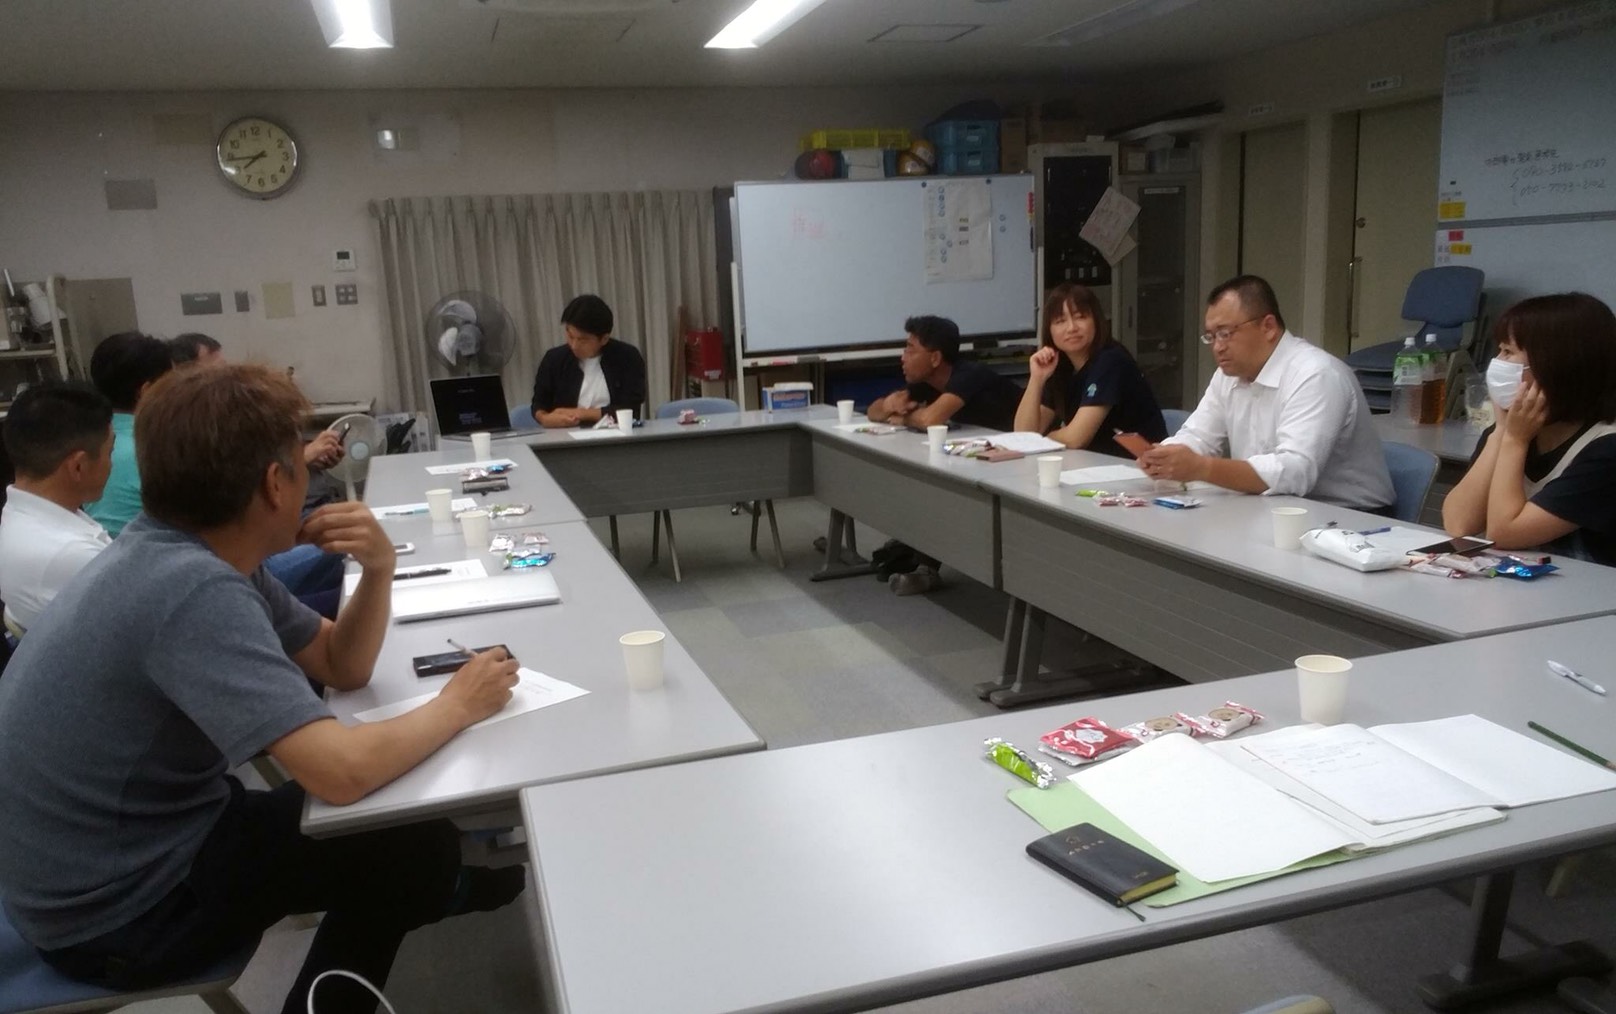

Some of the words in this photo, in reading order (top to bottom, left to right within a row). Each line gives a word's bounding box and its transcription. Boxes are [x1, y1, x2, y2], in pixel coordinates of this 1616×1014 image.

[240, 129, 247, 139] 11
[250, 126, 260, 136] 12
[268, 128, 272, 138] 1
[230, 140, 240, 149] 10
[276, 139, 284, 149] 2
[282, 151, 290, 161] 3
[279, 165, 286, 174] 4
[246, 174, 253, 184] 7
[258, 177, 265, 187] 6
[270, 174, 278, 184] 5
